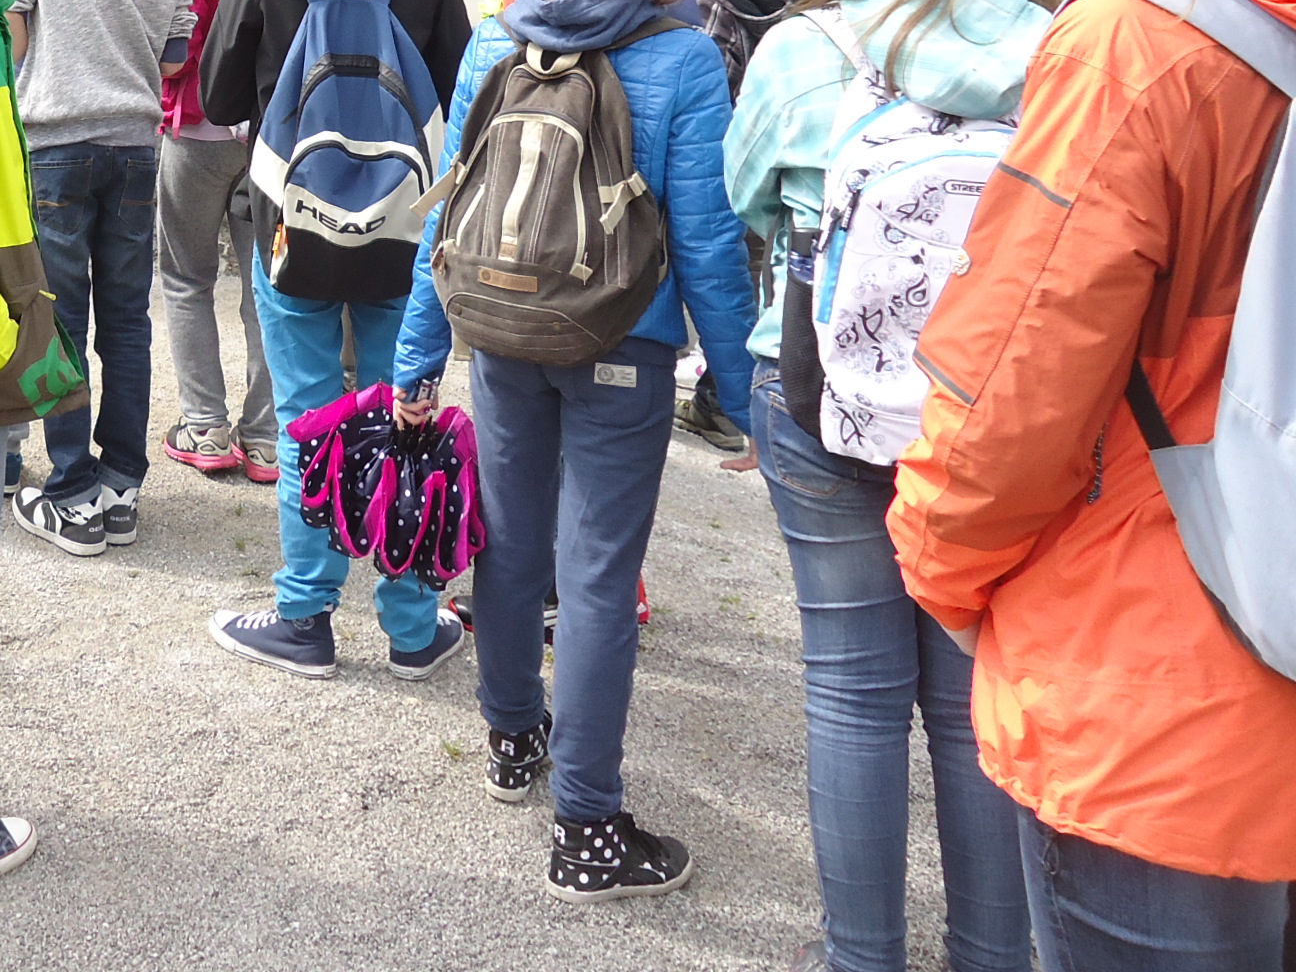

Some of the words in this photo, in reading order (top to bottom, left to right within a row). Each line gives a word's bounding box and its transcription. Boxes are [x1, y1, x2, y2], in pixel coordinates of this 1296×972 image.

[950, 183, 985, 193] STREE
[295, 200, 387, 235] HEAD
[500, 738, 515, 757] R
[554, 823, 566, 845] R
